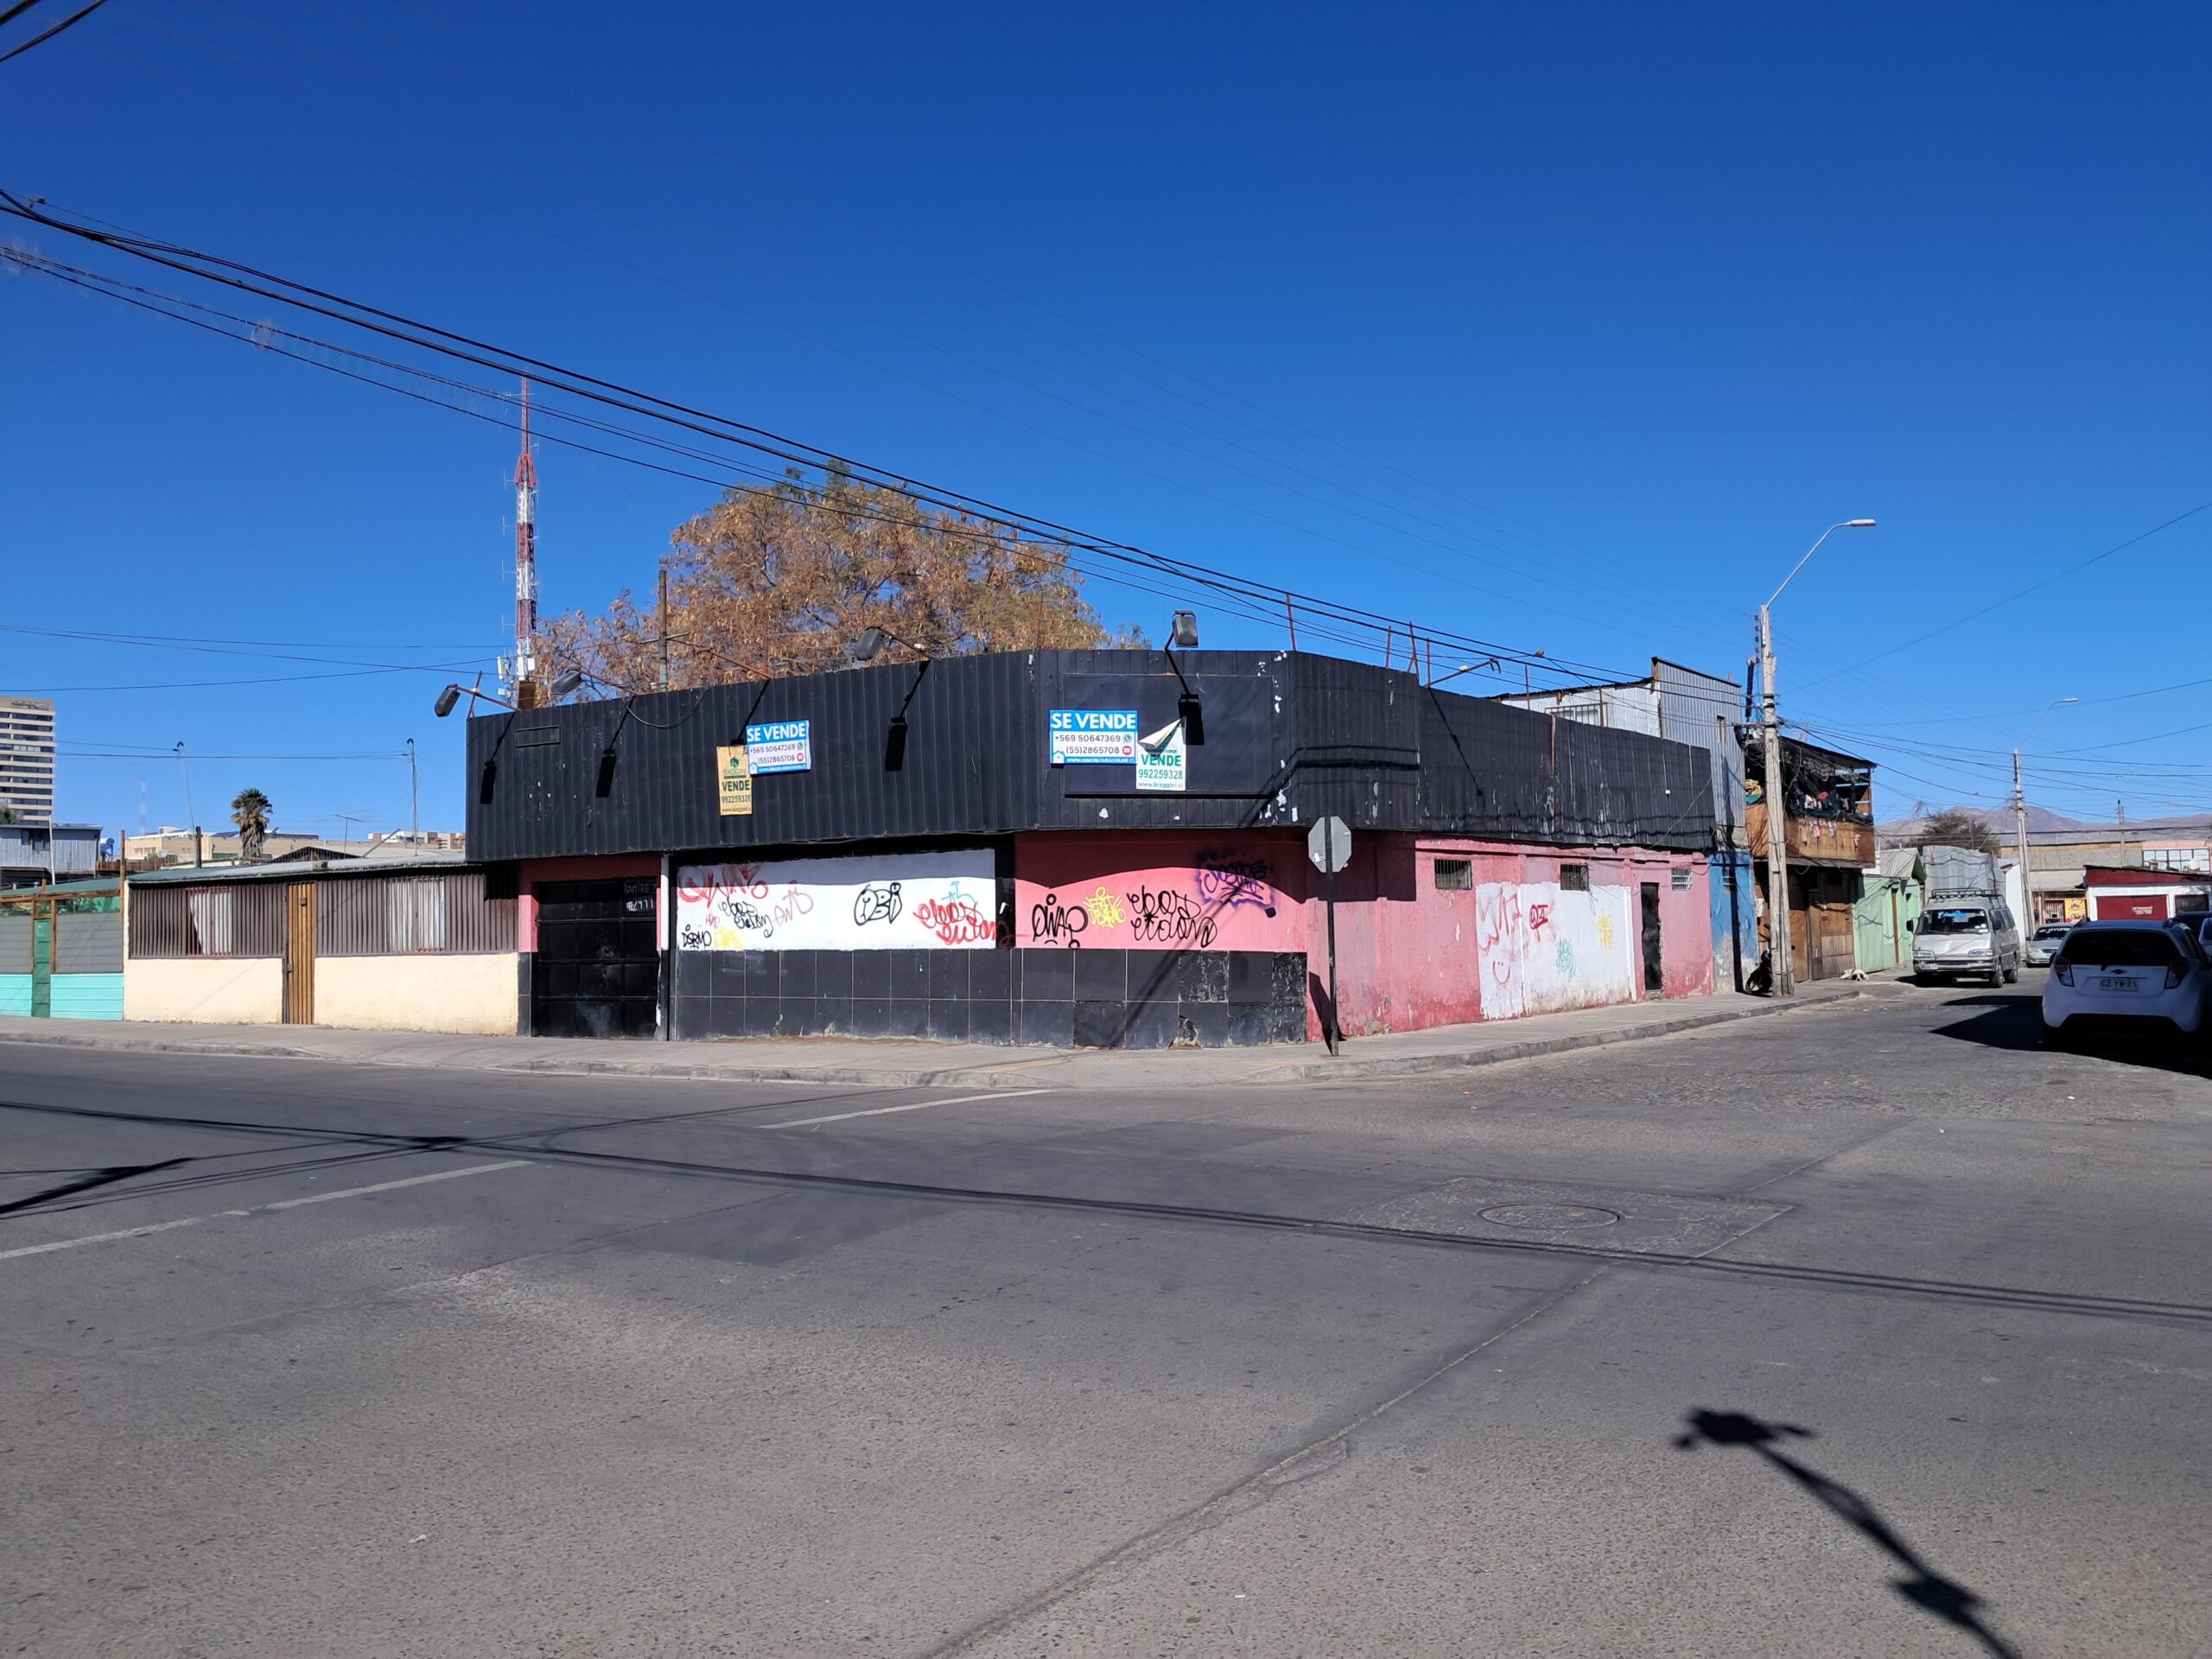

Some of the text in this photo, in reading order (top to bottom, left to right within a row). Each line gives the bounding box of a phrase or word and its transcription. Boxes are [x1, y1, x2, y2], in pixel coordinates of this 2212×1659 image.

[1051, 713, 1136, 729] SE VENDE
[747, 723, 805, 741] SE VENDE
[1066, 746, 1120, 754] (55)2865708
[1141, 753, 1182, 766] VENDE
[1138, 768, 1183, 779] 992259328
[721, 780, 750, 791] VENDE
